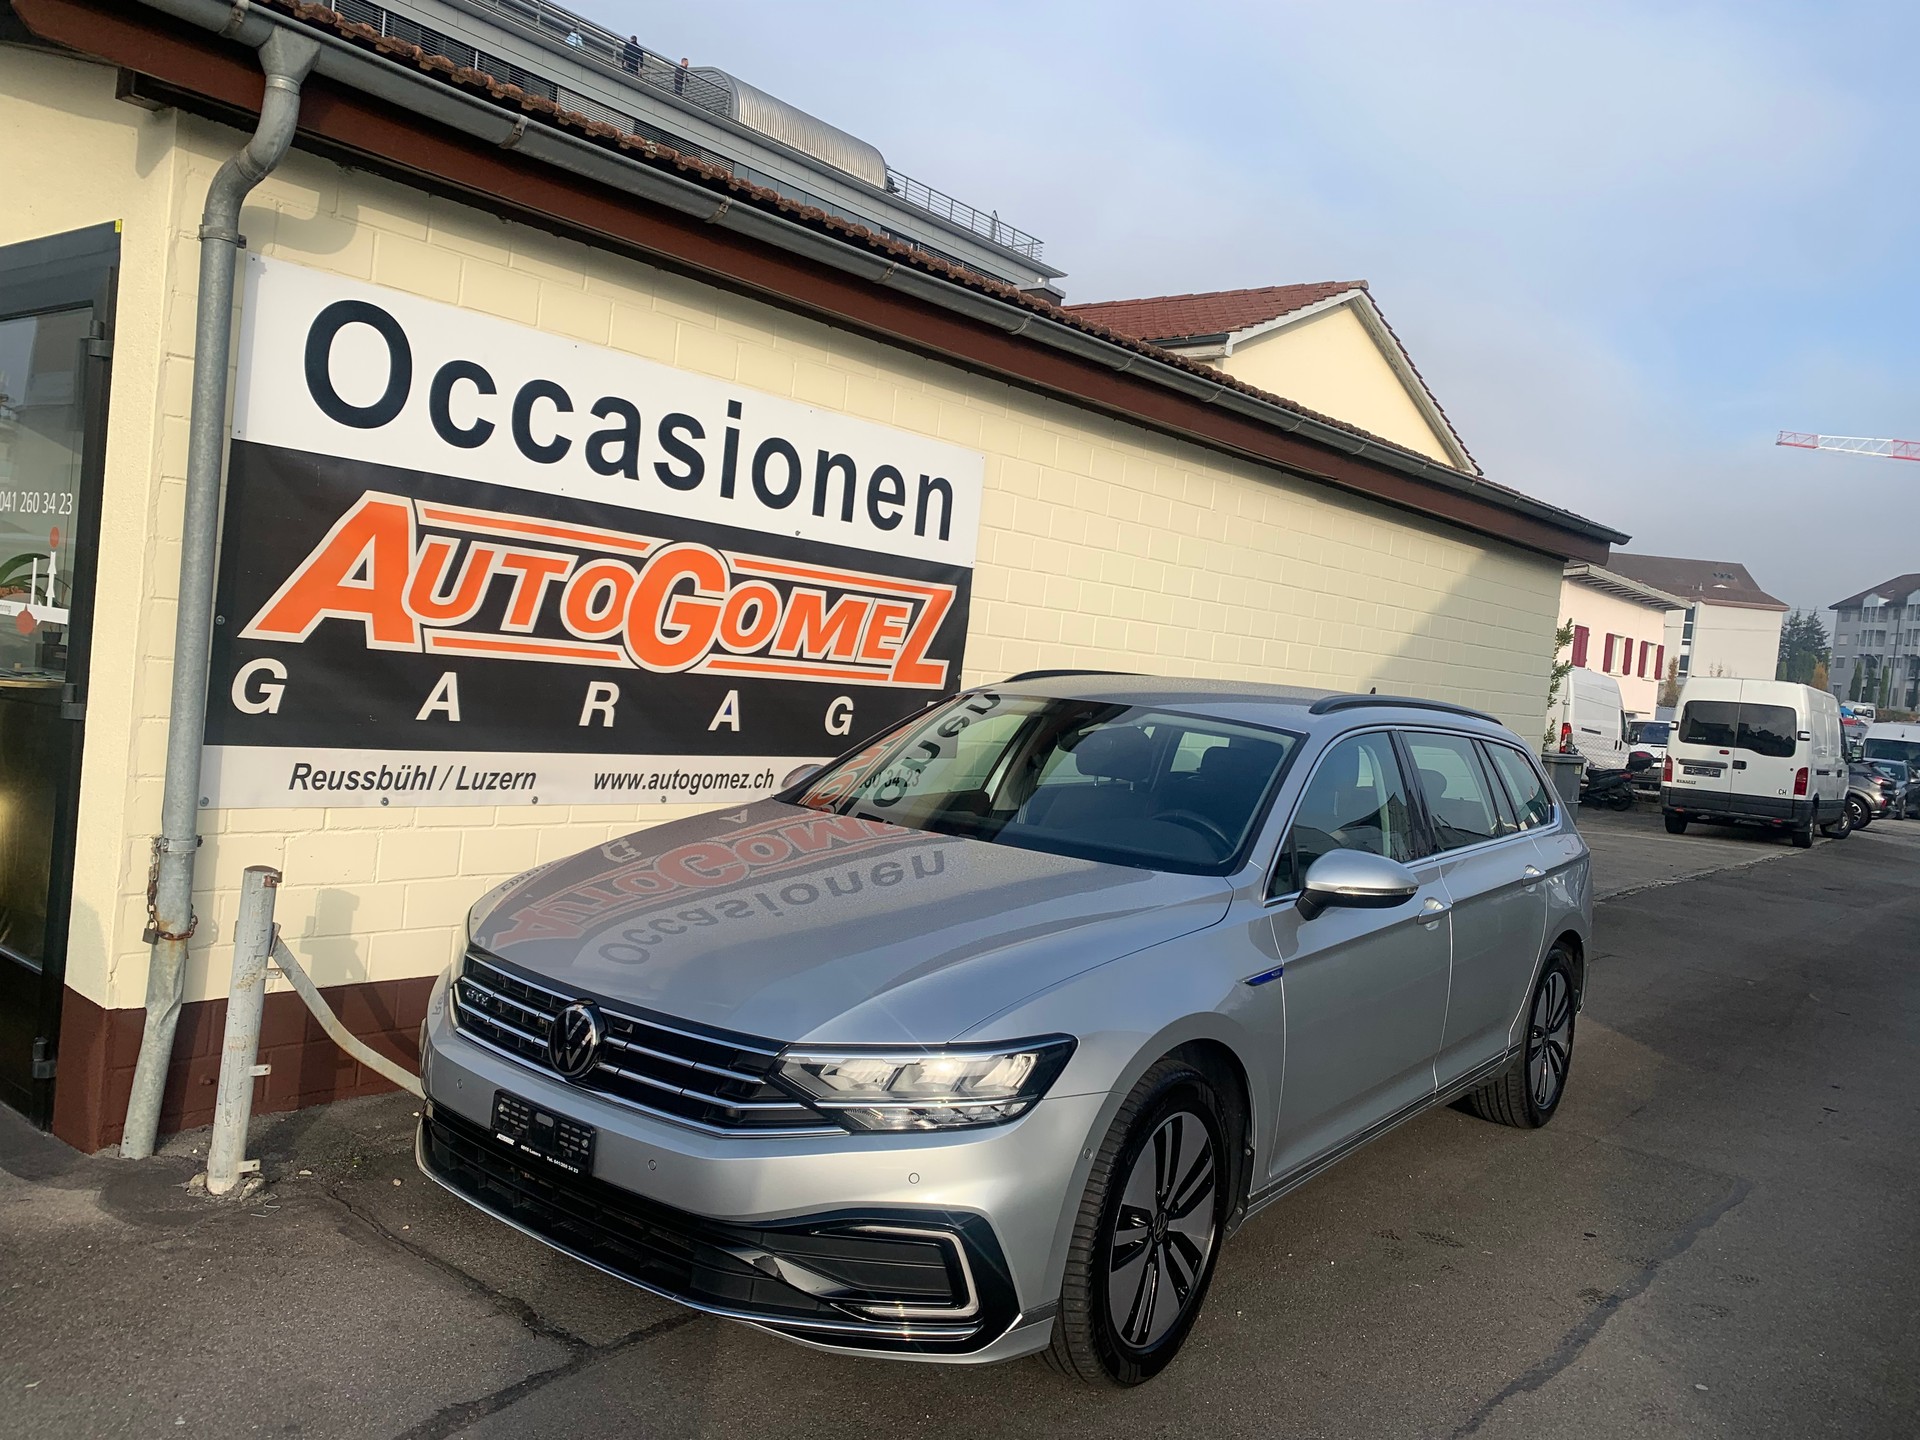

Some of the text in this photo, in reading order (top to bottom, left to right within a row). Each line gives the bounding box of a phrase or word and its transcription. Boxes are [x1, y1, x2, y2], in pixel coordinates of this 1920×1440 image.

[305, 299, 954, 542] Occasionen
[20, 491, 40, 513] 260
[42, 492, 56, 514] 34
[58, 493, 73, 515] 23
[288, 762, 437, 792] Reussbühl
[455, 765, 538, 792] Luzern
[593, 768, 775, 796] www.autogomez.ch
[1778, 788, 1787, 796] CH
